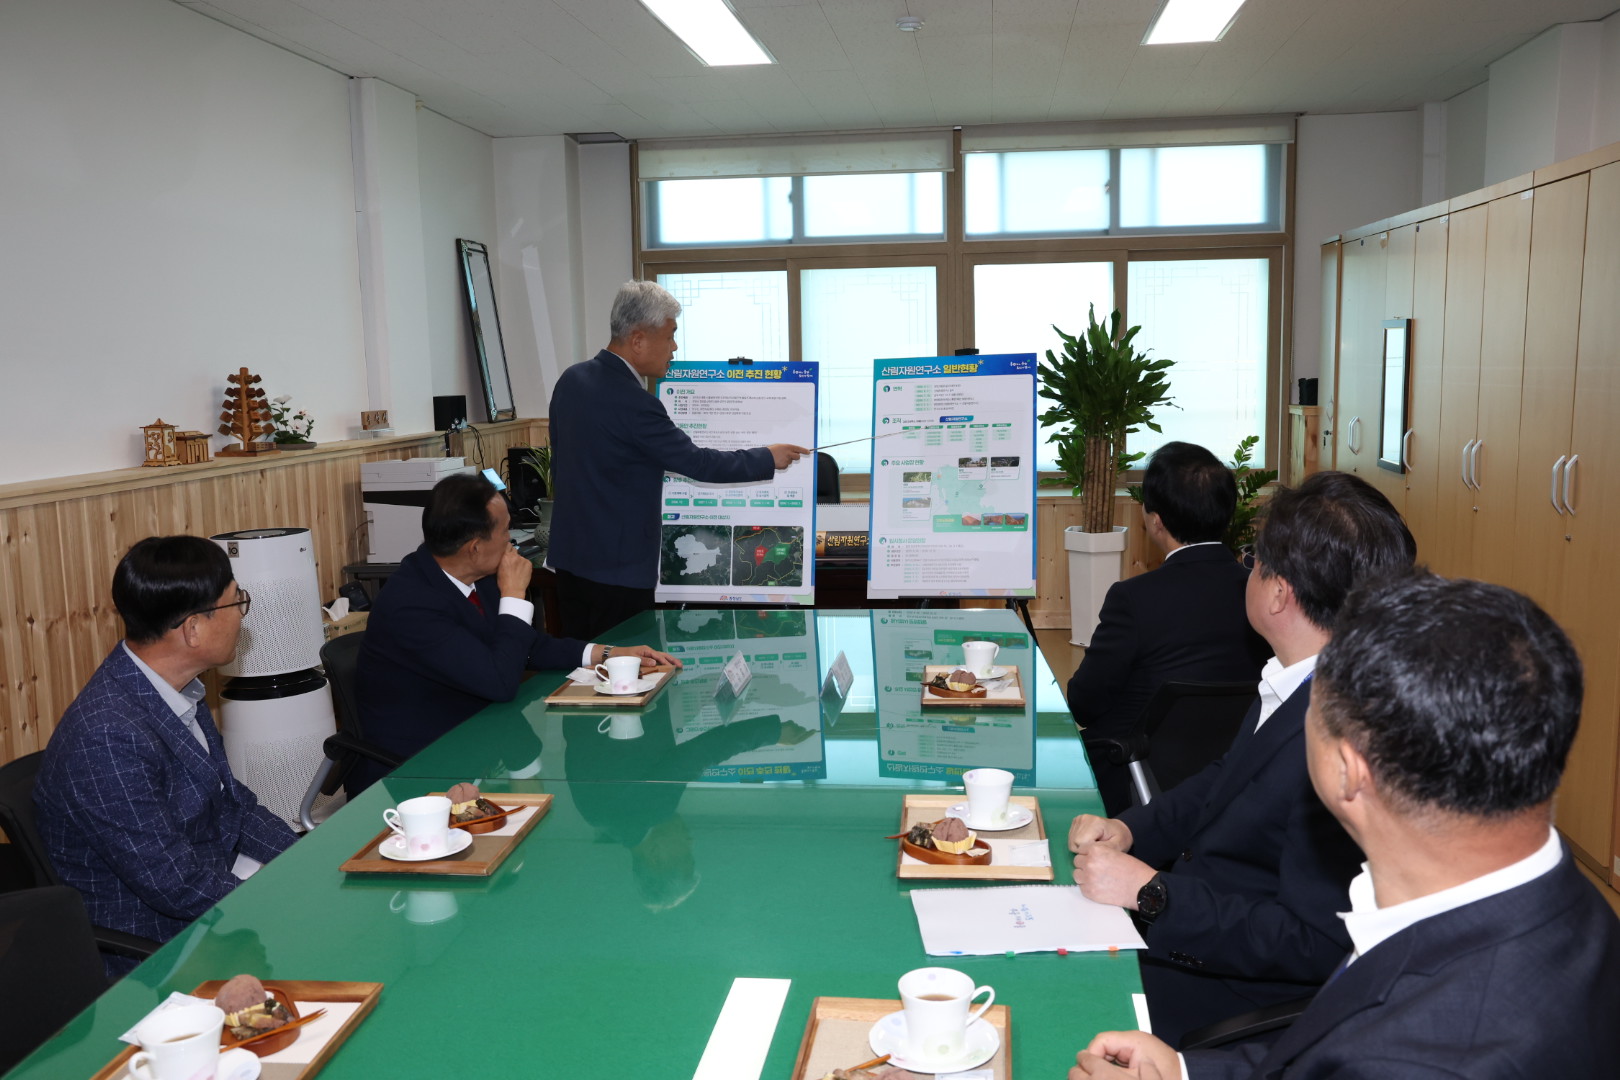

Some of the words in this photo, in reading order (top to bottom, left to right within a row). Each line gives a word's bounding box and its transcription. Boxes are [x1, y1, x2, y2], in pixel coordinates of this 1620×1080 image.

[665, 369, 725, 379] 산림자원연구소
[727, 370, 744, 379] 이전
[746, 370, 763, 379] 추진
[764, 370, 782, 379] 현황
[881, 366, 942, 376] 산림자원연구소
[943, 364, 979, 374] 일반현황
